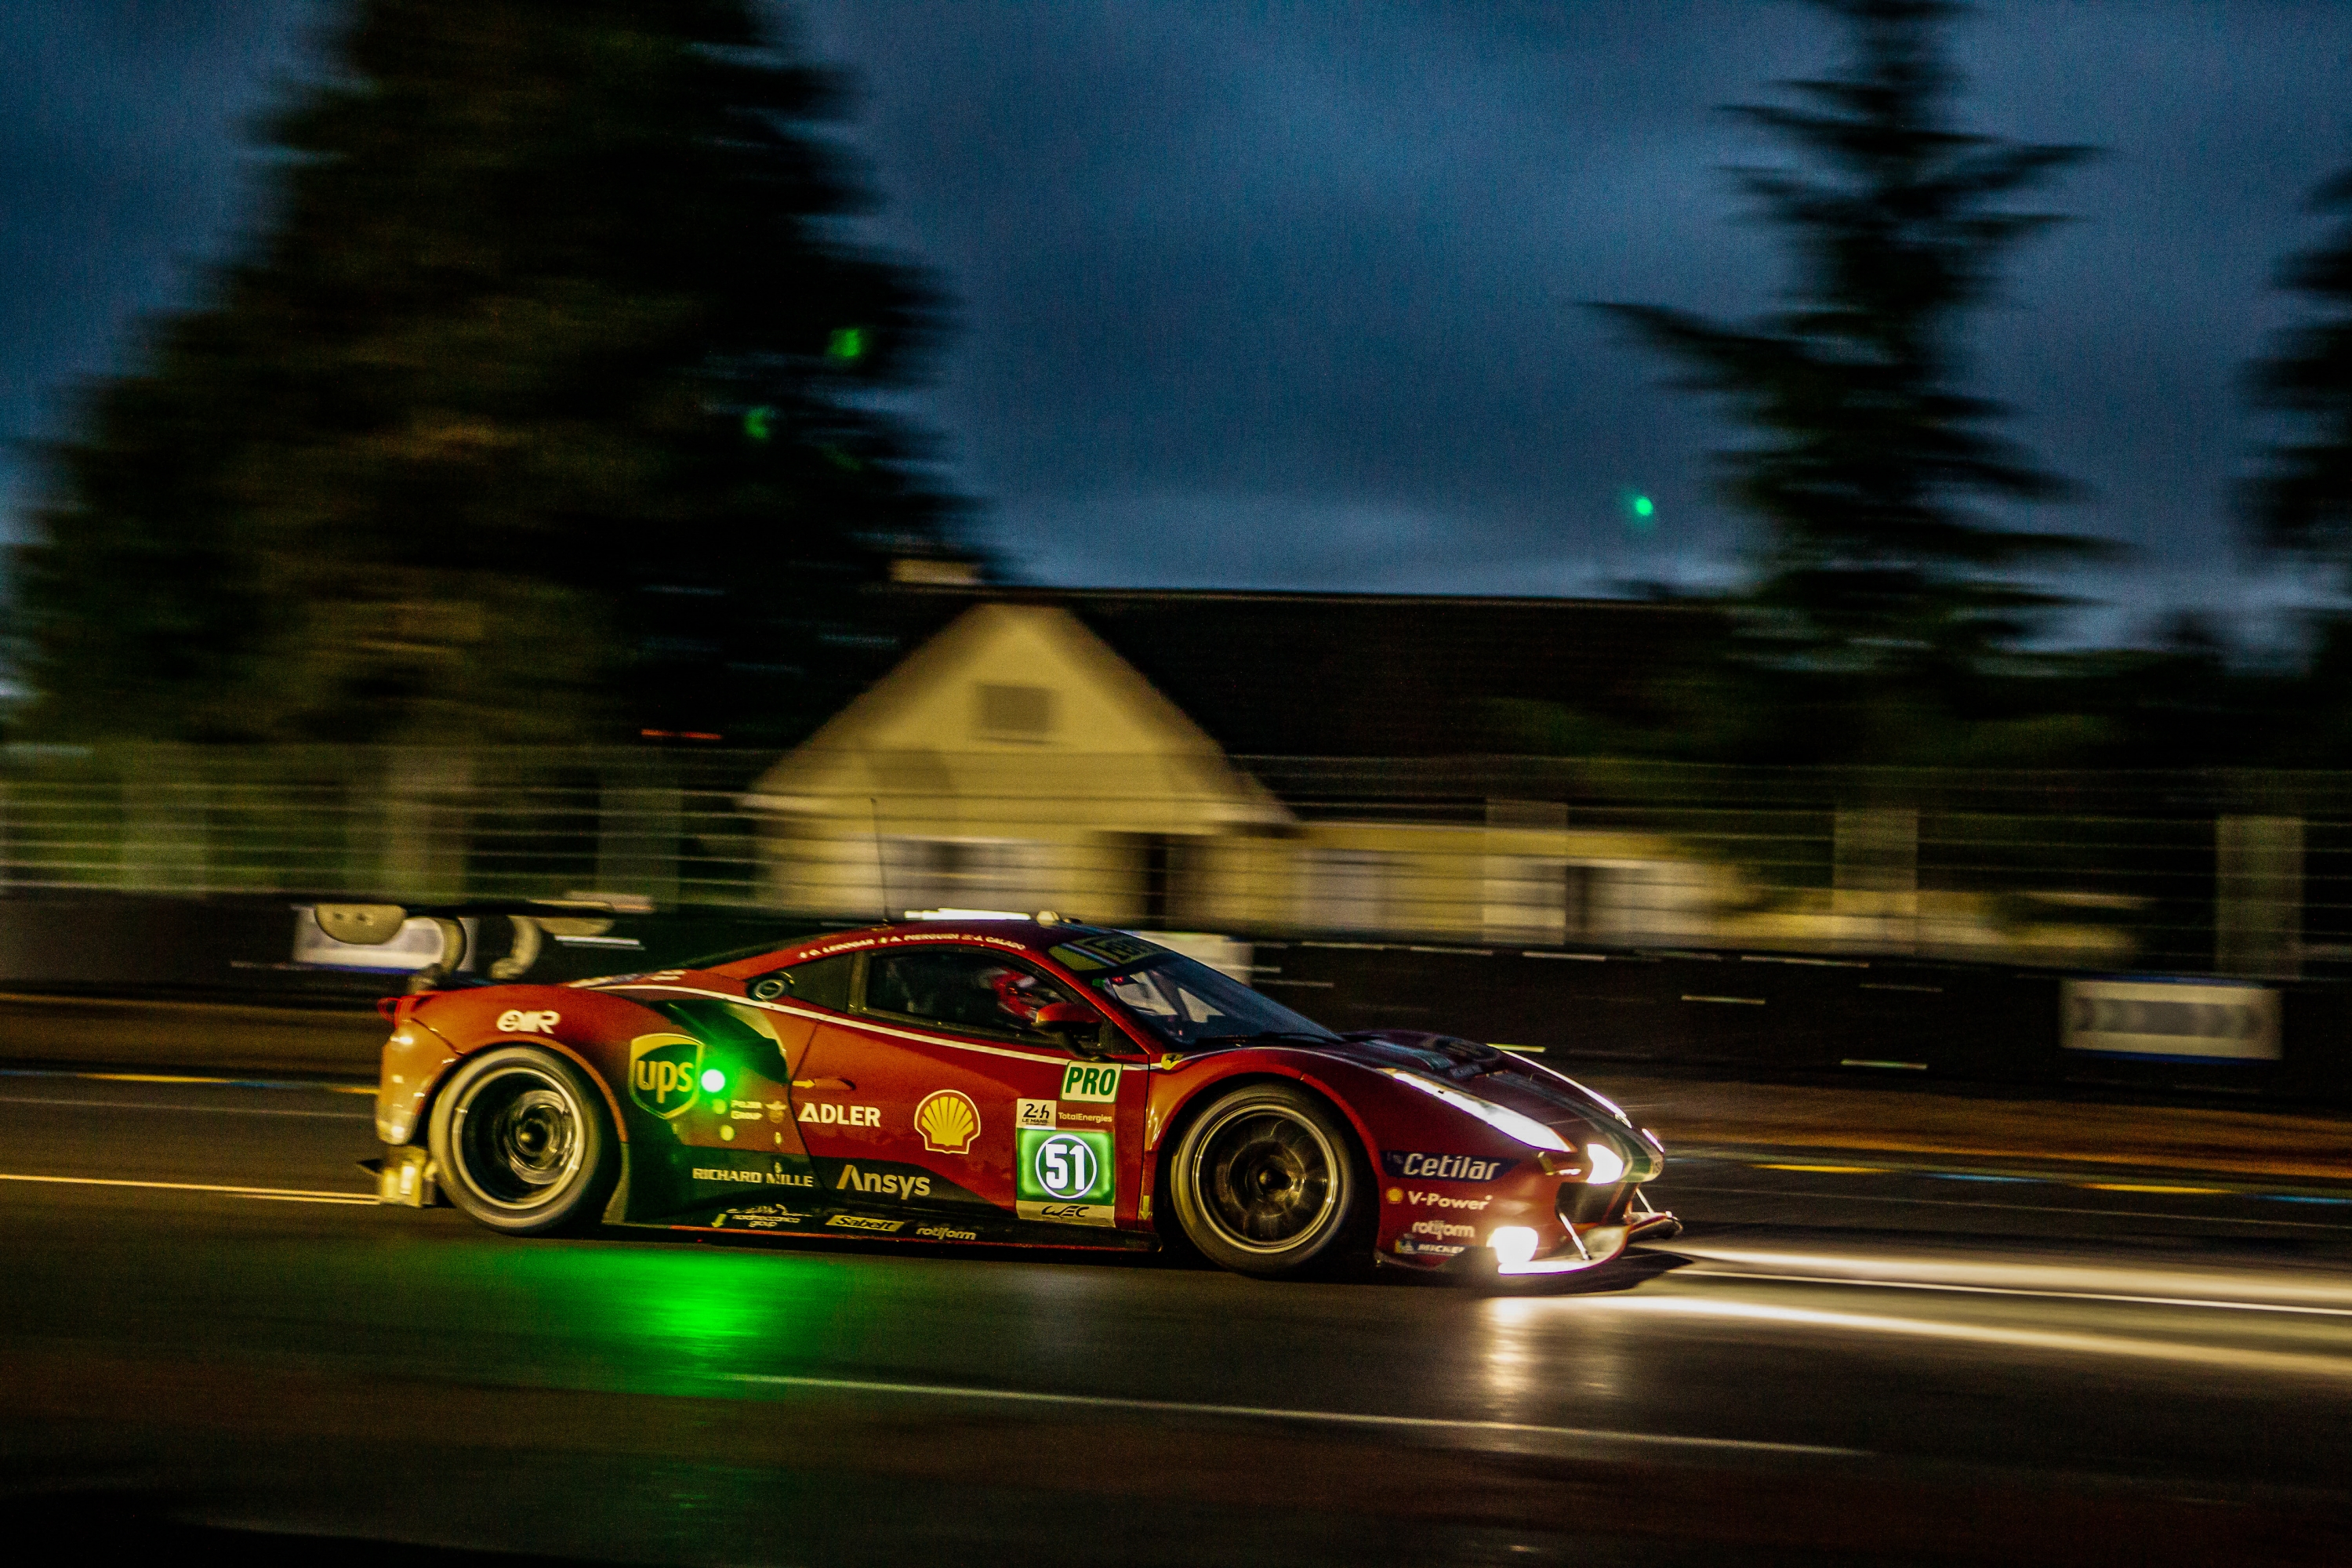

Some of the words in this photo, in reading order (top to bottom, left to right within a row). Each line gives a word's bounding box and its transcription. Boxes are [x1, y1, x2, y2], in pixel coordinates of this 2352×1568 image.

[637, 1060, 694, 1104] ups
[1065, 1066, 1116, 1096] PRO
[797, 1102, 882, 1127] ADLER
[1058, 1112, 1112, 1123] TotalEnergies
[692, 1167, 763, 1184] RICHARD
[1045, 1143, 1085, 1191] 51
[1403, 1152, 1501, 1181] Cetilar
[836, 1164, 931, 1200] Ansys
[1041, 1205, 1090, 1218] WEC
[1407, 1190, 1490, 1210] V-Power
